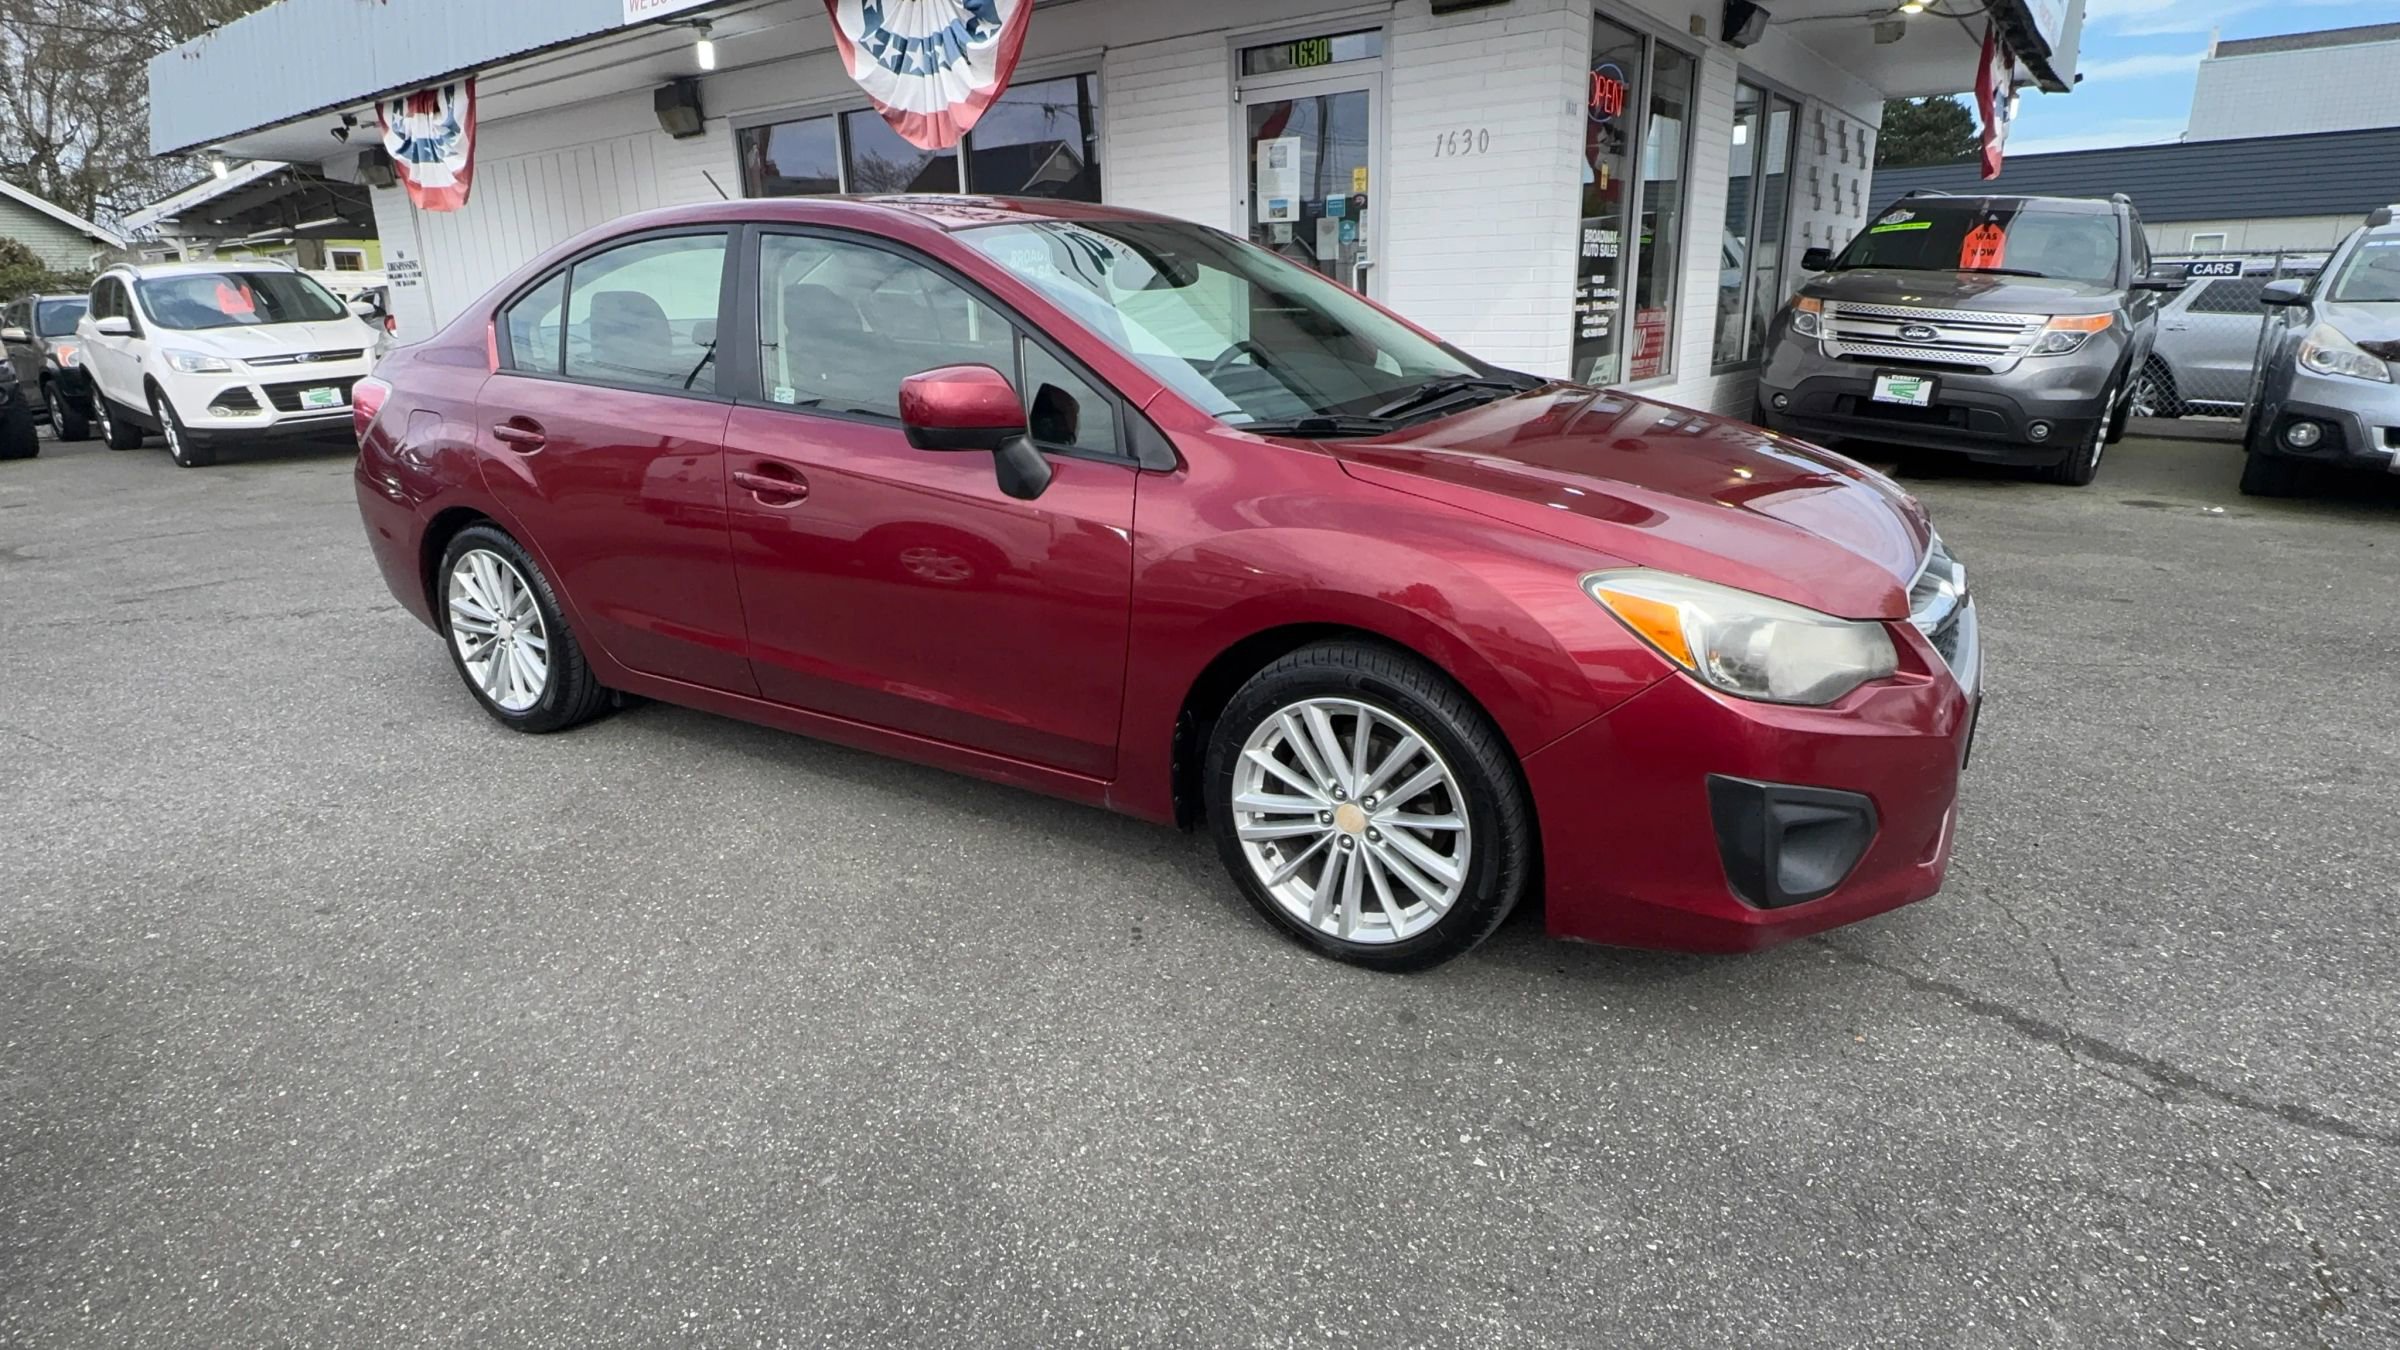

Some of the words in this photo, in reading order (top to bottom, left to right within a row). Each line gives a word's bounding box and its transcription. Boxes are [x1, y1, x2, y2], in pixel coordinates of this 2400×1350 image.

[1291, 39, 1328, 67] 1630
[1589, 70, 1624, 118] OPEN
[1434, 128, 1489, 157] 1630
[1584, 228, 1618, 244] BROADWAY
[1976, 232, 1998, 241] WAS
[1582, 243, 1599, 257] AUTO
[1599, 244, 1618, 258] SALES
[1971, 248, 1997, 257] NOW
[2192, 263, 2235, 275] CARS
[1905, 326, 1932, 338] Ford
